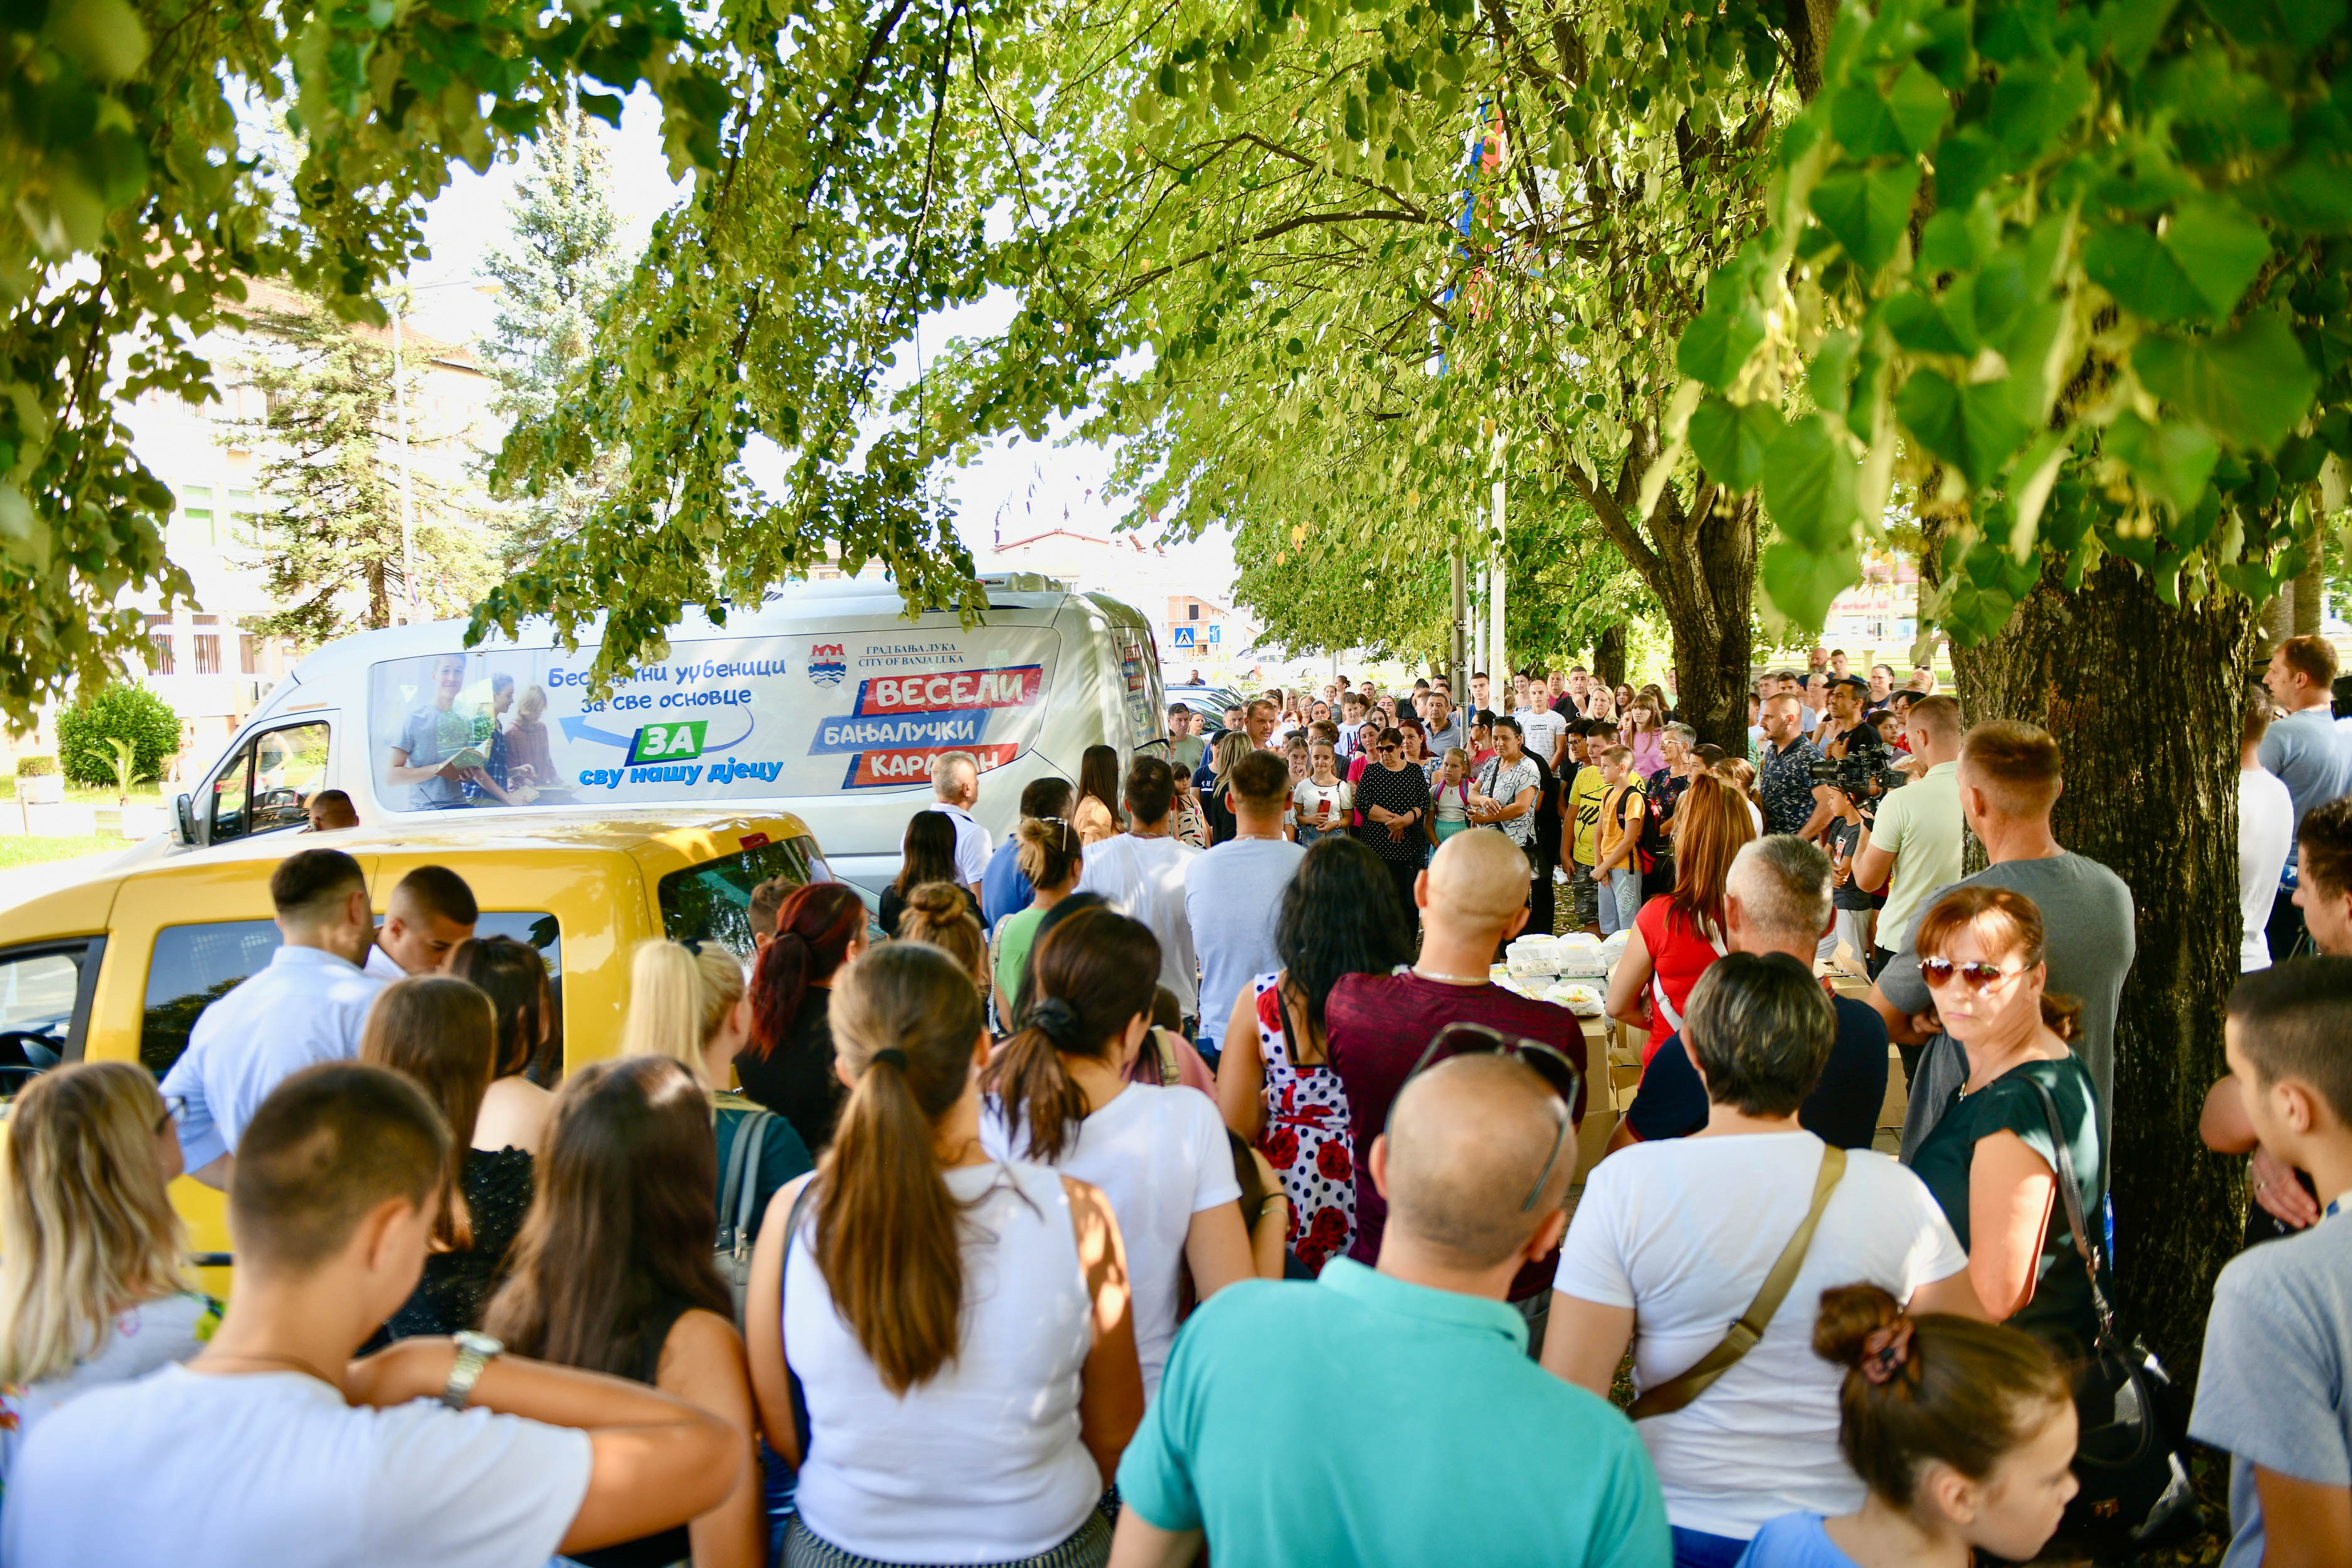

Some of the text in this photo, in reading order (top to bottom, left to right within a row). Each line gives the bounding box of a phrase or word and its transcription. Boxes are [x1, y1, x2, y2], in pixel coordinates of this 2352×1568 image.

[859, 655, 964, 667] CITY OF BANJA LUKA
[866, 643, 956, 655] ГРАД БАЊА ЛУКА
[675, 659, 786, 685] уџбеници
[613, 695, 652, 710] све
[659, 689, 751, 708] основце
[876, 674, 1024, 707] ВЕСЕЛИ
[642, 725, 696, 755] ЗА
[824, 720, 975, 745] БАЊАЛУЧКИ
[579, 756, 784, 789] сву нашу дјецу
